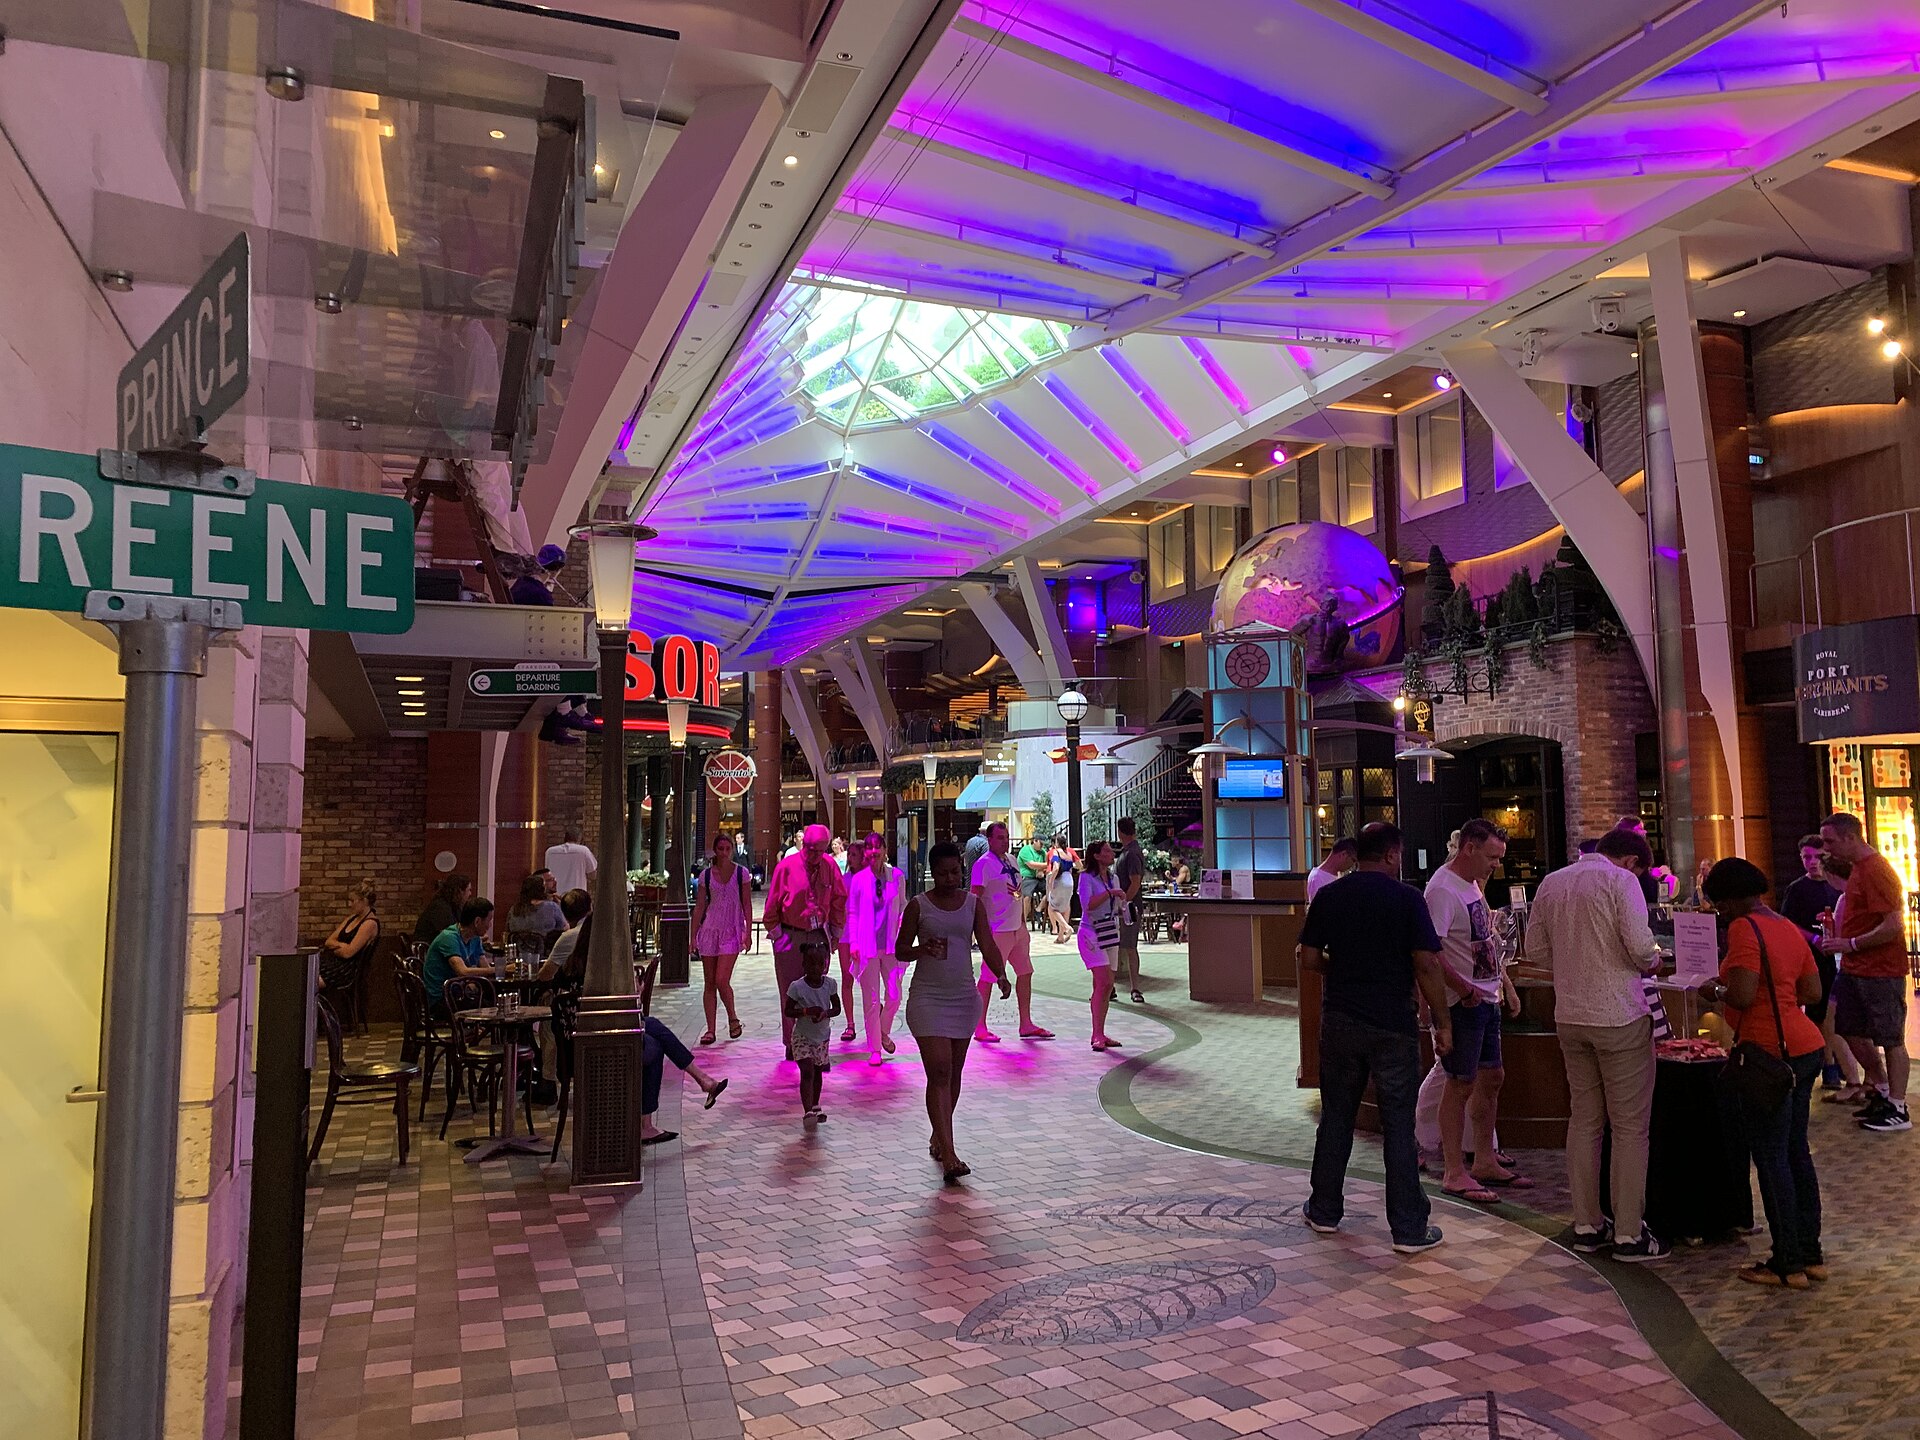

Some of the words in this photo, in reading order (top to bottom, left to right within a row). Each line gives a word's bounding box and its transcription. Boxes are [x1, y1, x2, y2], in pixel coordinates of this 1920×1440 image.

[122, 266, 240, 451] PRINCE
[18, 472, 399, 612] REENE
[1815, 650, 1838, 661] ROYAL
[624, 629, 720, 707] SOR
[1807, 664, 1850, 681] PORT
[515, 673, 561, 682] DEPARTURE
[516, 683, 560, 691] BOARDING
[1813, 703, 1851, 717] CARIBBEAN
[706, 766, 755, 777] Sorrento's
